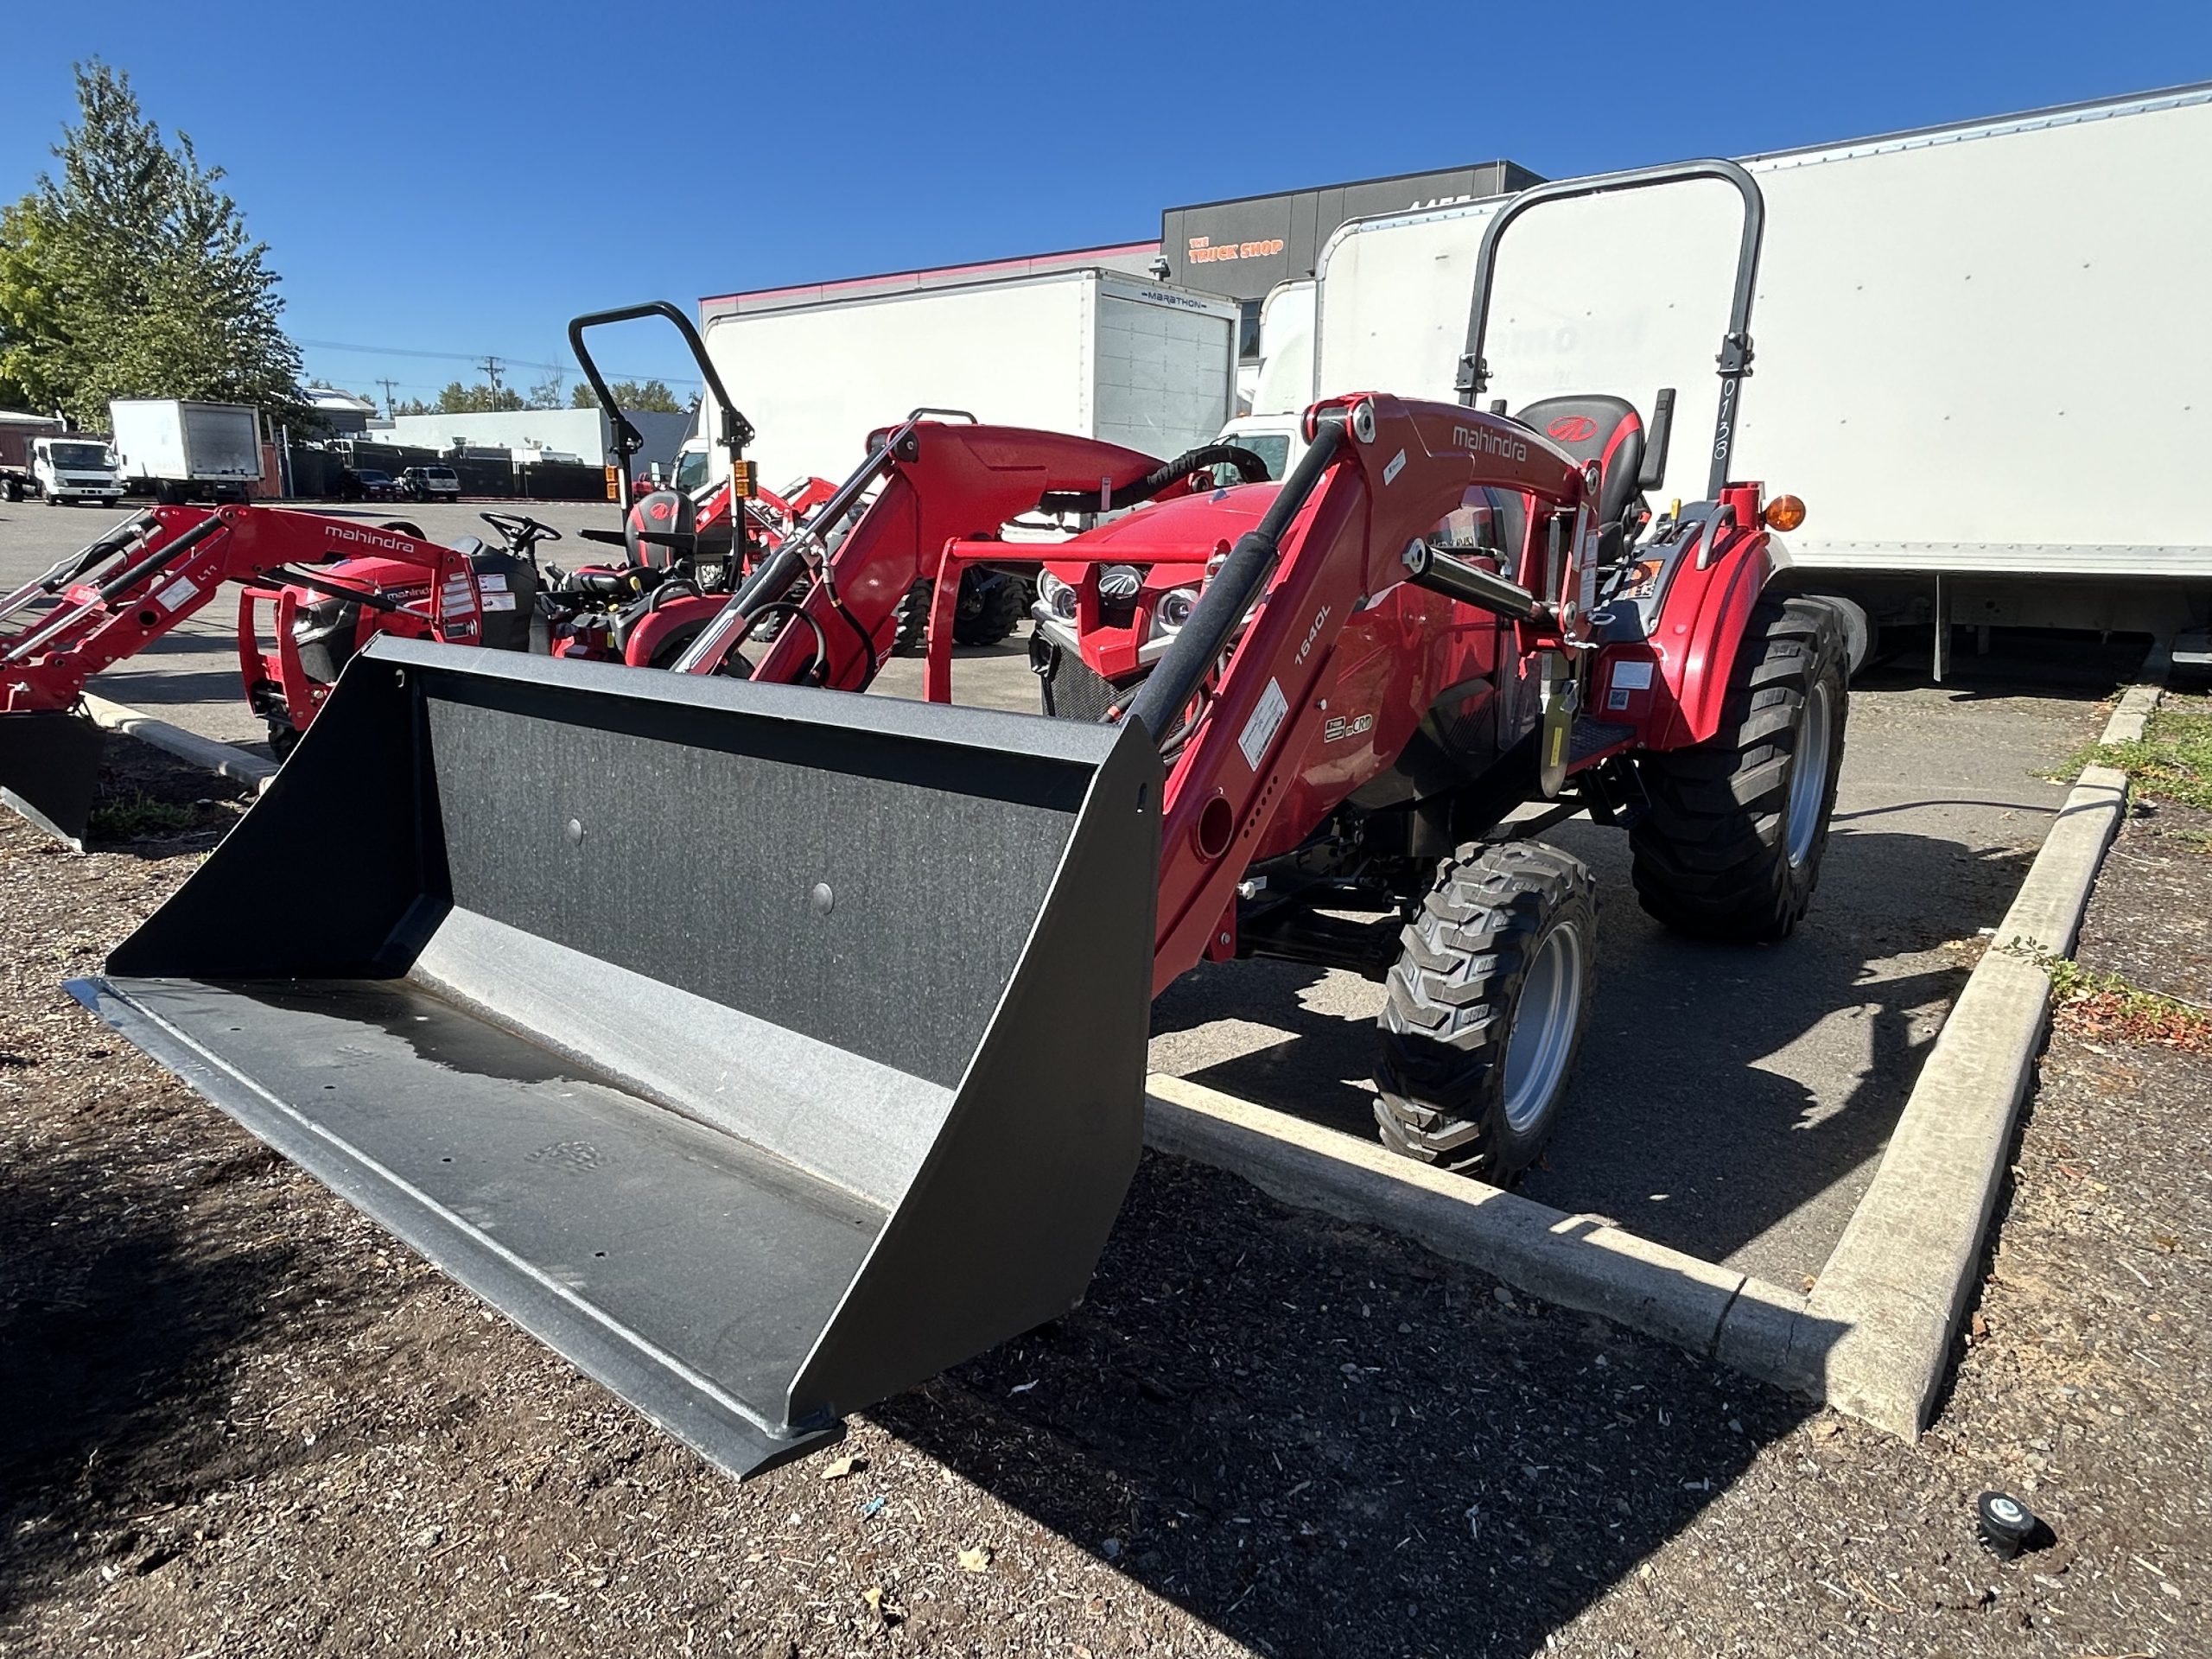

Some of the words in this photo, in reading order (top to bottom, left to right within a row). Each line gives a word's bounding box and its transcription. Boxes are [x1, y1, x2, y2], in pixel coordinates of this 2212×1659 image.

[1189, 245, 1239, 264] TRUCK
[1240, 239, 1284, 258] SHOP
[1713, 378, 1736, 460] 0138
[1452, 425, 1528, 462] mahindra
[325, 525, 415, 553] mahindra
[196, 565, 218, 582] L11
[386, 587, 433, 601] mahind
[1294, 605, 1332, 666] 1640L
